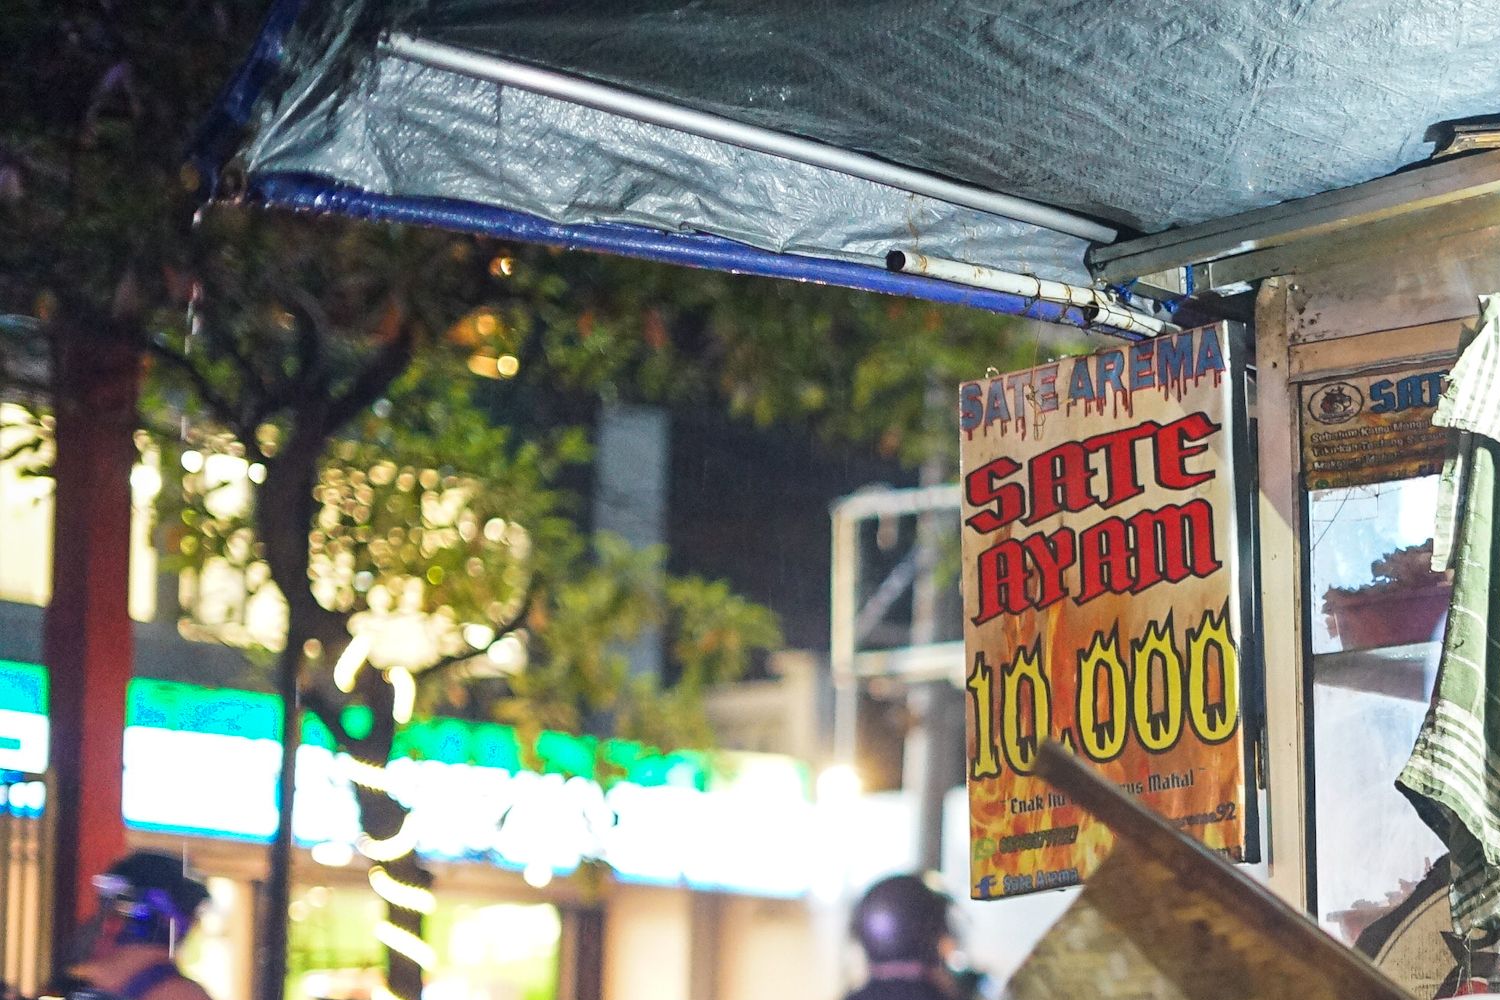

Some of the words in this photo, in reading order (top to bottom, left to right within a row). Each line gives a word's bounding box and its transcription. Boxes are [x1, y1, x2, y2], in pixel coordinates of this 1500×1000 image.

[961, 364, 1060, 435] SATE
[1066, 324, 1228, 415] AREMA
[1369, 369, 1450, 414] SAT
[965, 411, 1221, 533] SATE
[972, 497, 1222, 627] AYAM
[1148, 768, 1195, 793] Mahal
